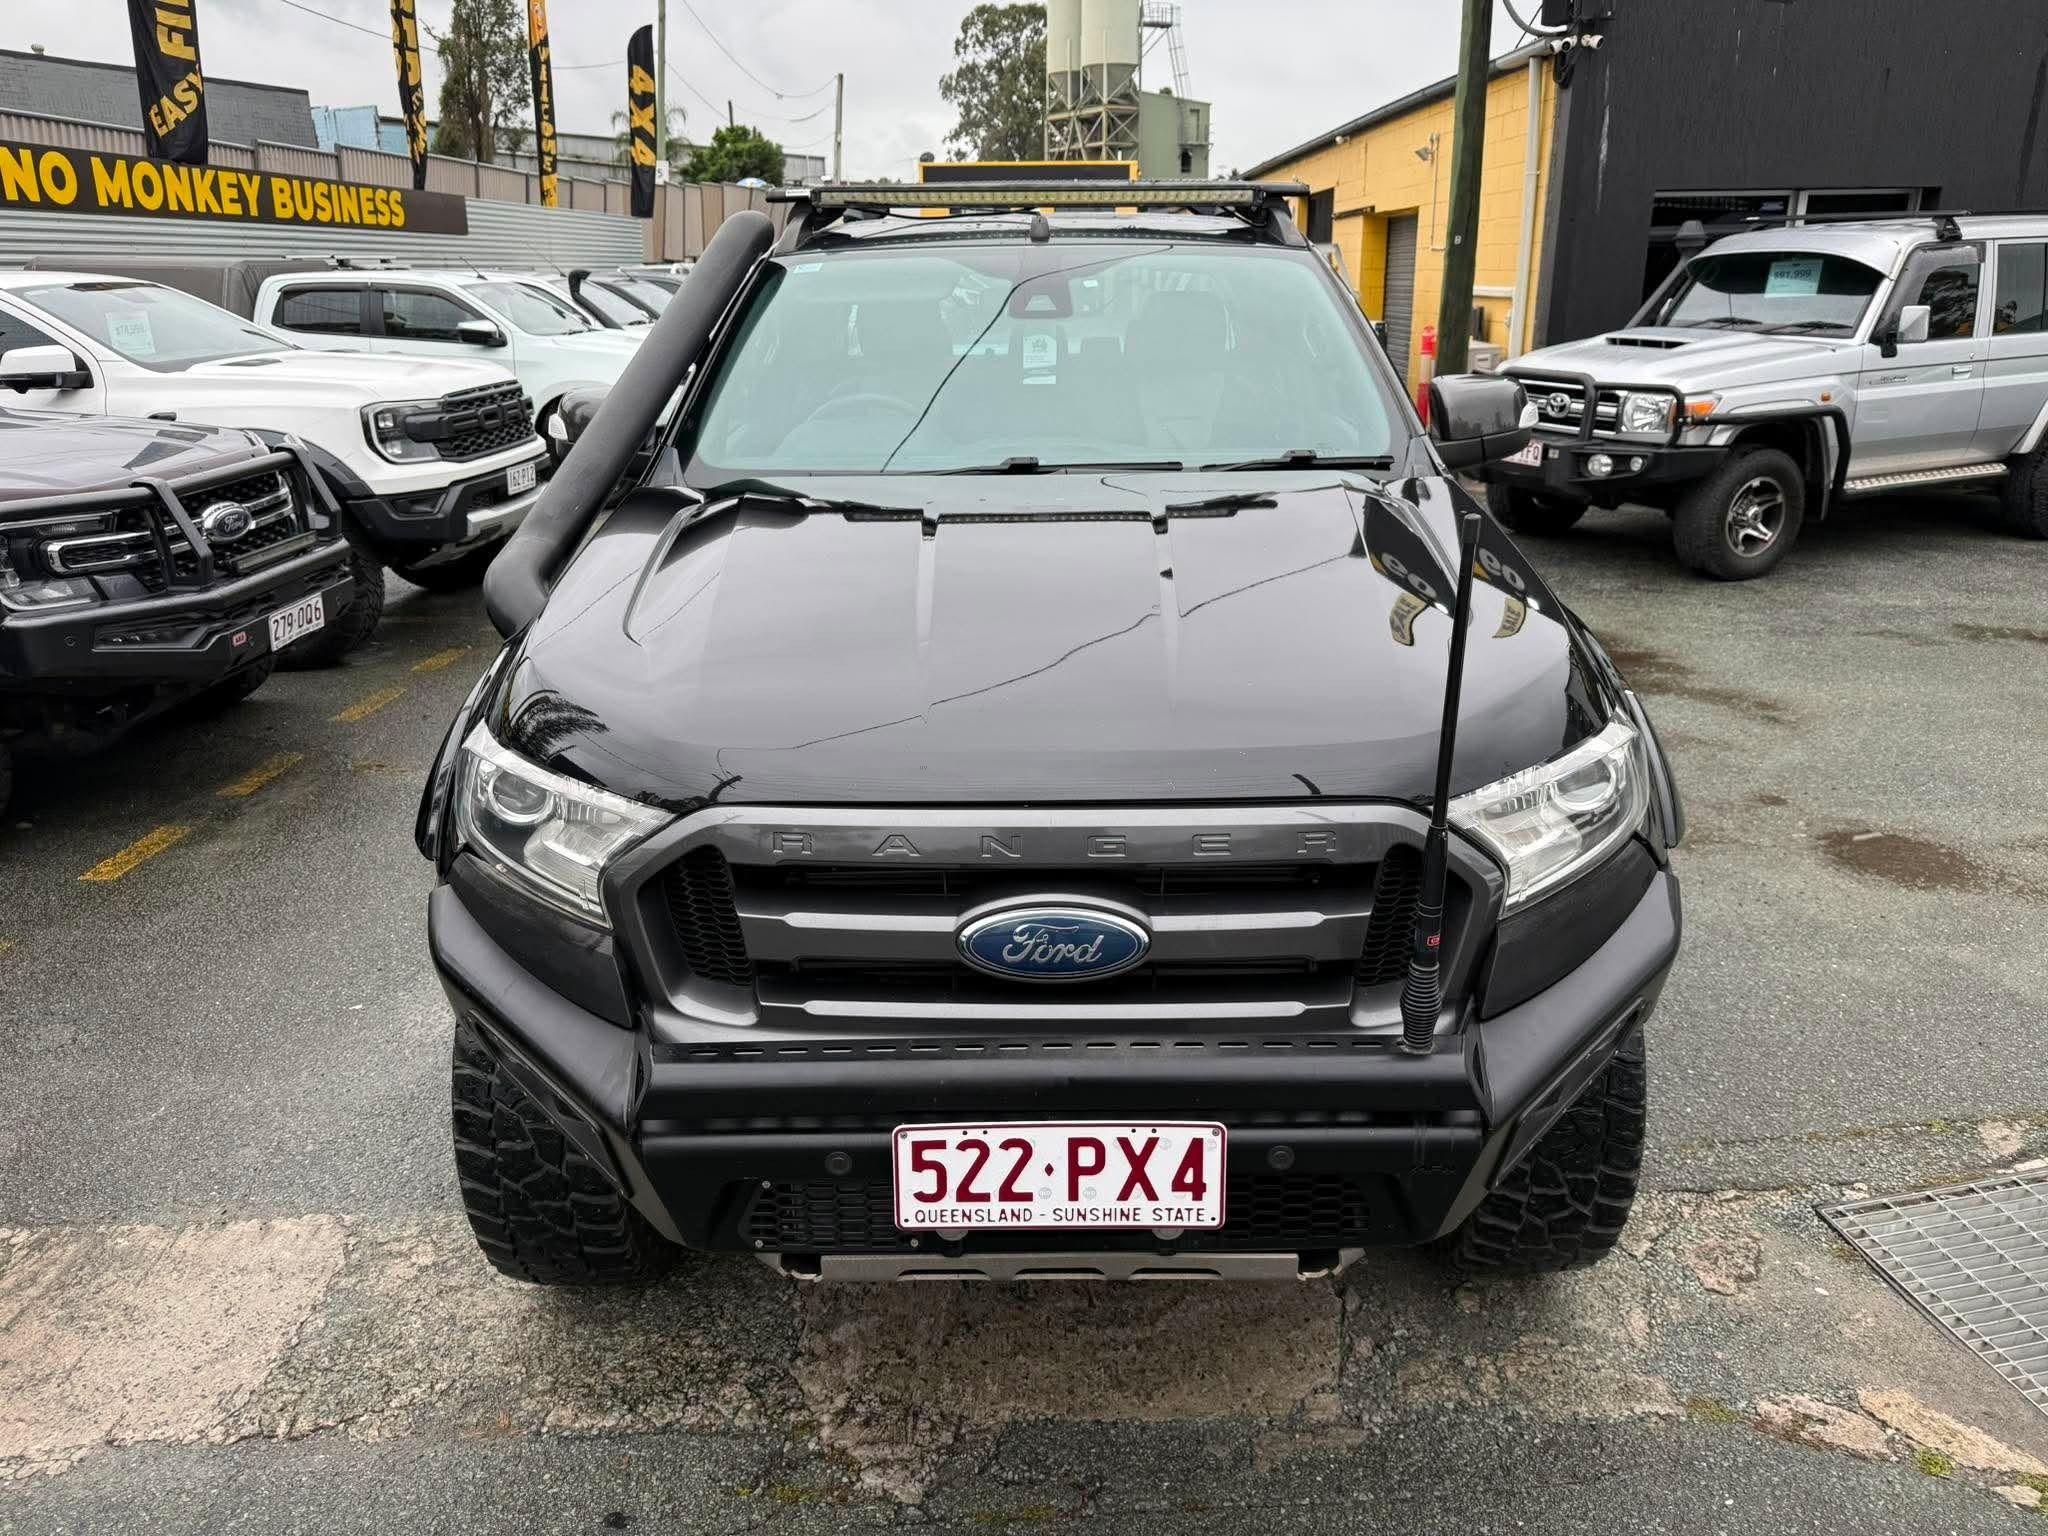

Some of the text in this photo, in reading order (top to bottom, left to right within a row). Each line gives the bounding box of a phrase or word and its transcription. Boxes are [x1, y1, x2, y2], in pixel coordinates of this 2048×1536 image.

[149, 64, 204, 138] EASY
[0, 148, 405, 227] NO MONKEY BUSINESS
[772, 832, 1337, 859] RANGER
[1002, 923, 1106, 964] Ford
[914, 1208, 1034, 1224] QUEENSLAND
[1052, 1207, 1142, 1223] SUNSHINE
[1151, 1206, 1206, 1223] STATE
